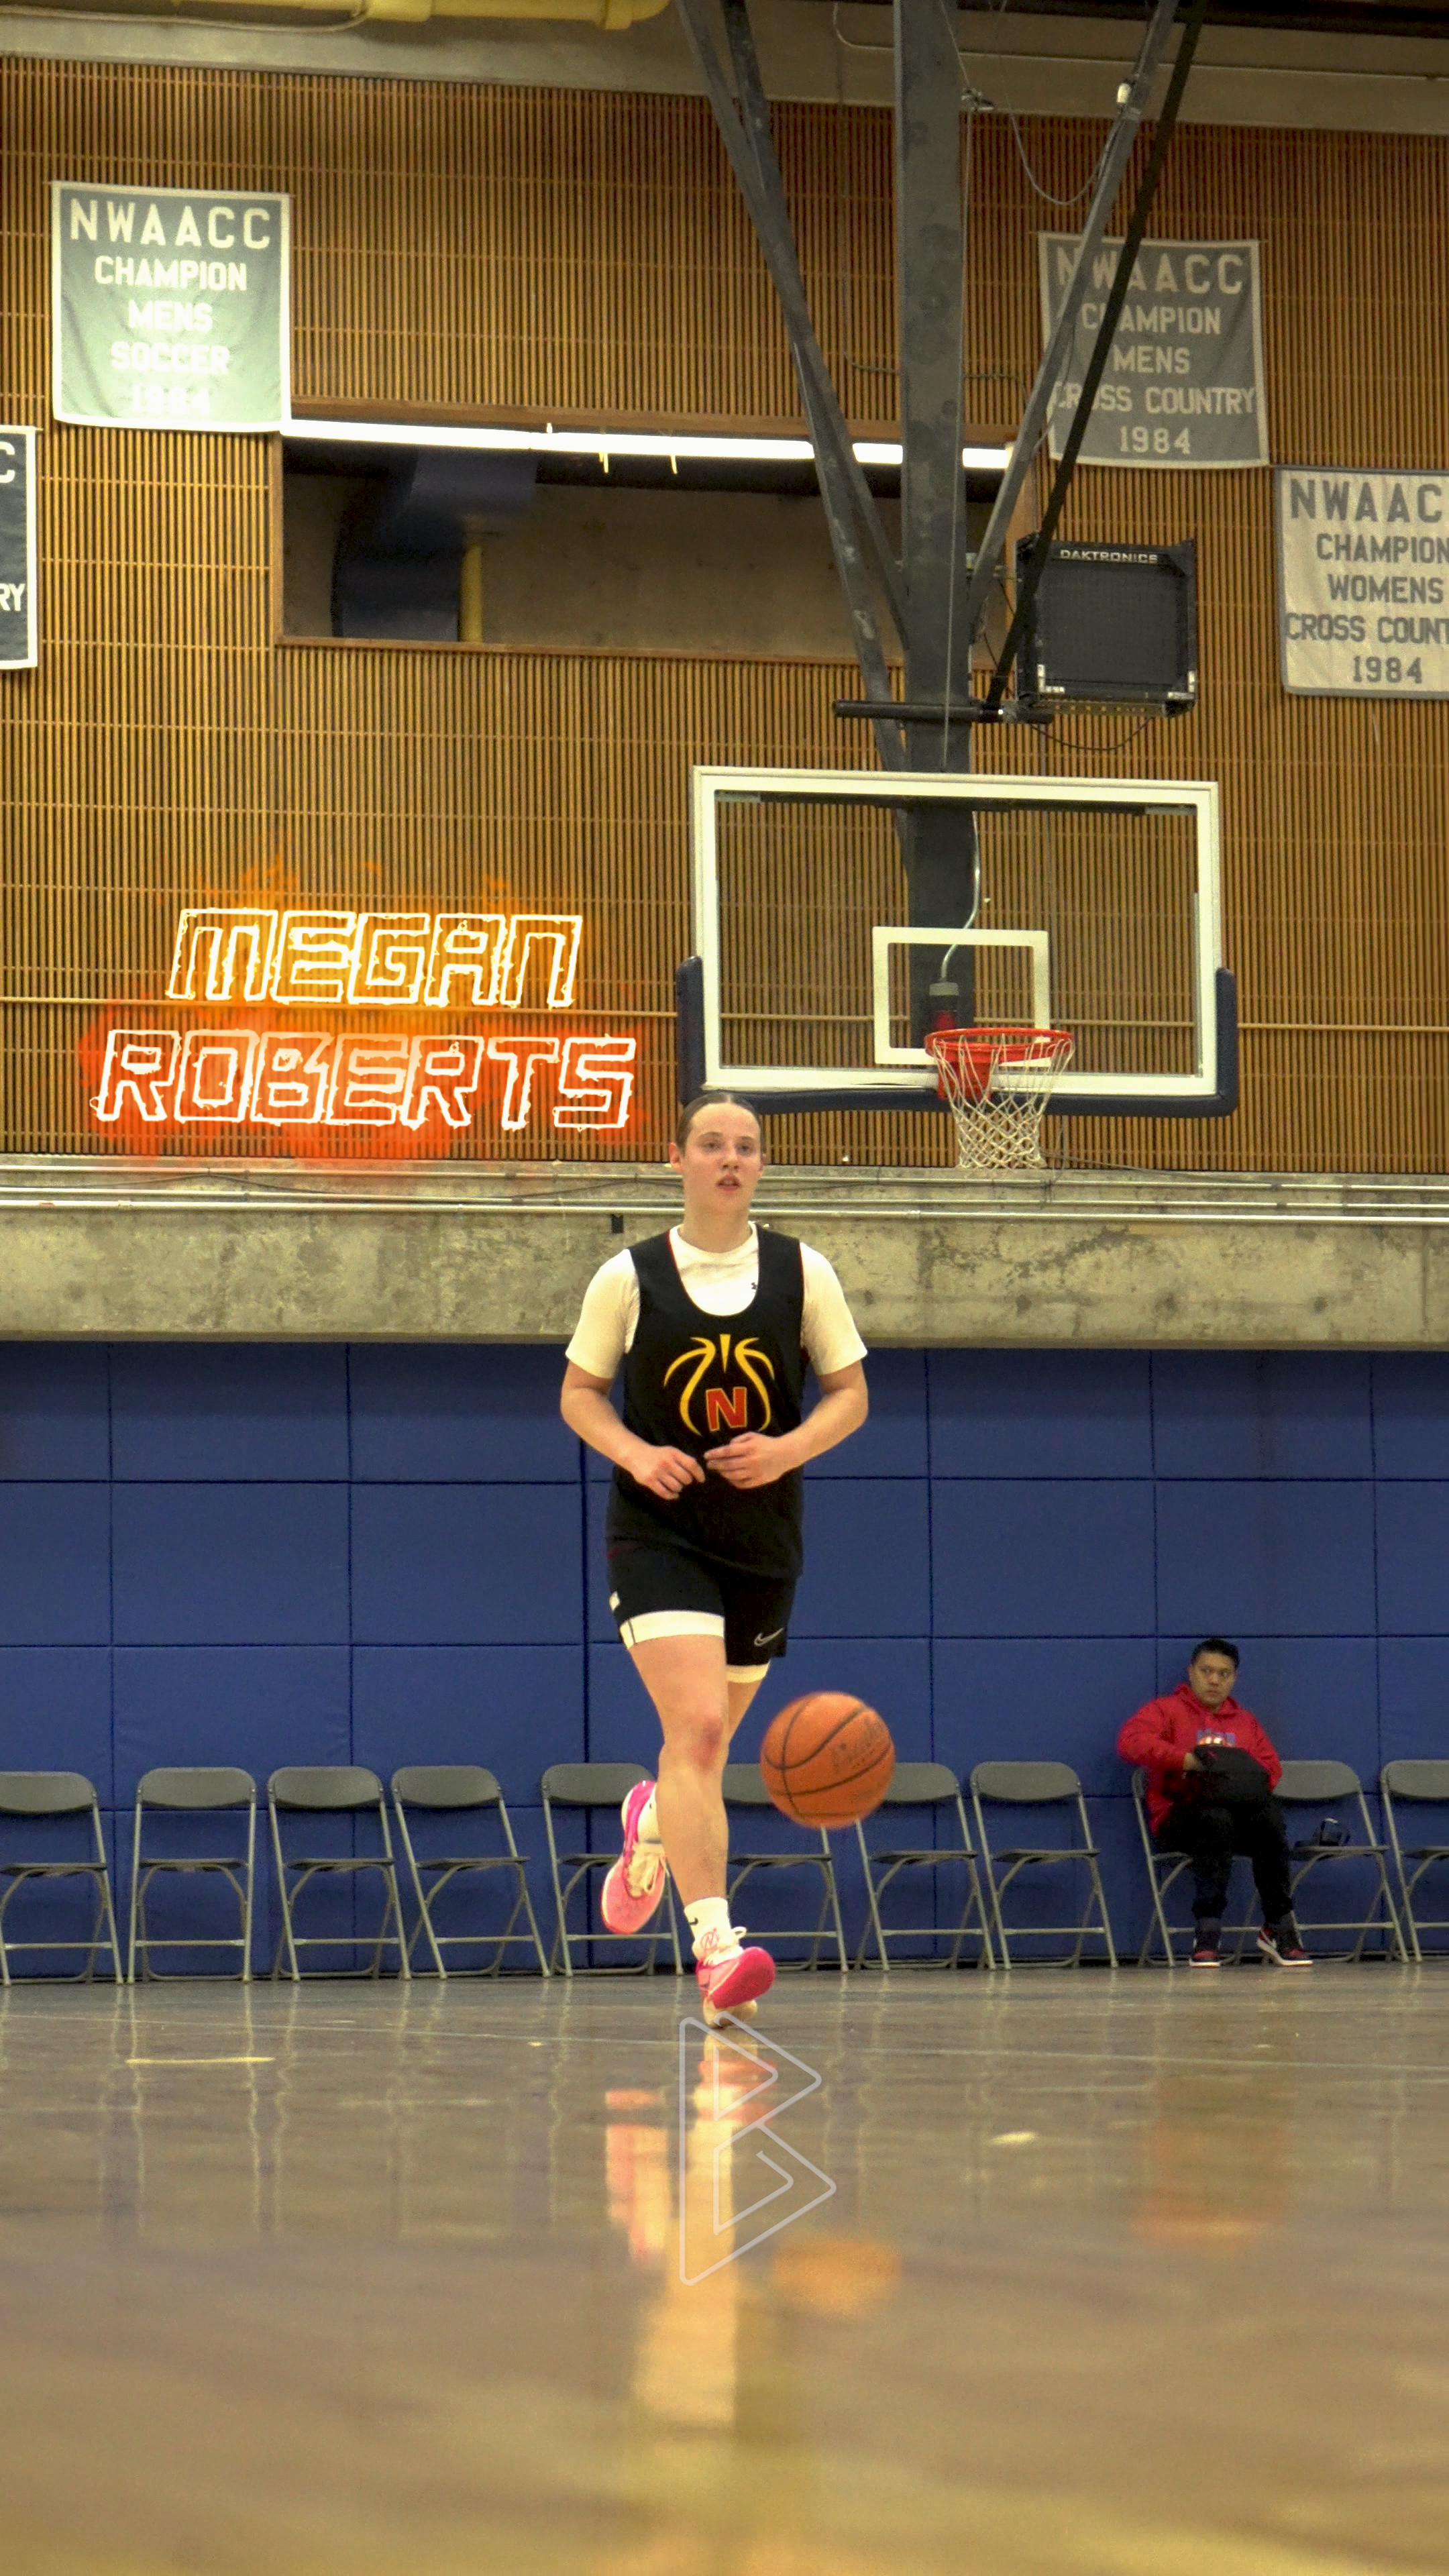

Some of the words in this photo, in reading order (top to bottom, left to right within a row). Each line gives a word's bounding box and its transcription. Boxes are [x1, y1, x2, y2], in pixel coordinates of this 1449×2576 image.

[70, 199, 270, 249] NWAACC
[95, 256, 247, 290] CHAMPION
[128, 300, 213, 331] MENS
[111, 341, 231, 374] SOCCER
[1113, 344, 1191, 374] MENS
[132, 384, 209, 415] 1984
[1145, 387, 1256, 415] COUNTRY
[1120, 425, 1191, 454] 1984
[1290, 479, 1442, 523] NWAAC
[1060, 549, 1159, 564] DAKTRONICS
[1316, 533, 1449, 564] CHAMPION
[1328, 574, 1444, 604] WOMENS
[1285, 612, 1365, 642] CROSS
[1352, 655, 1423, 684] 1984
[706, 1386, 747, 1432] N
